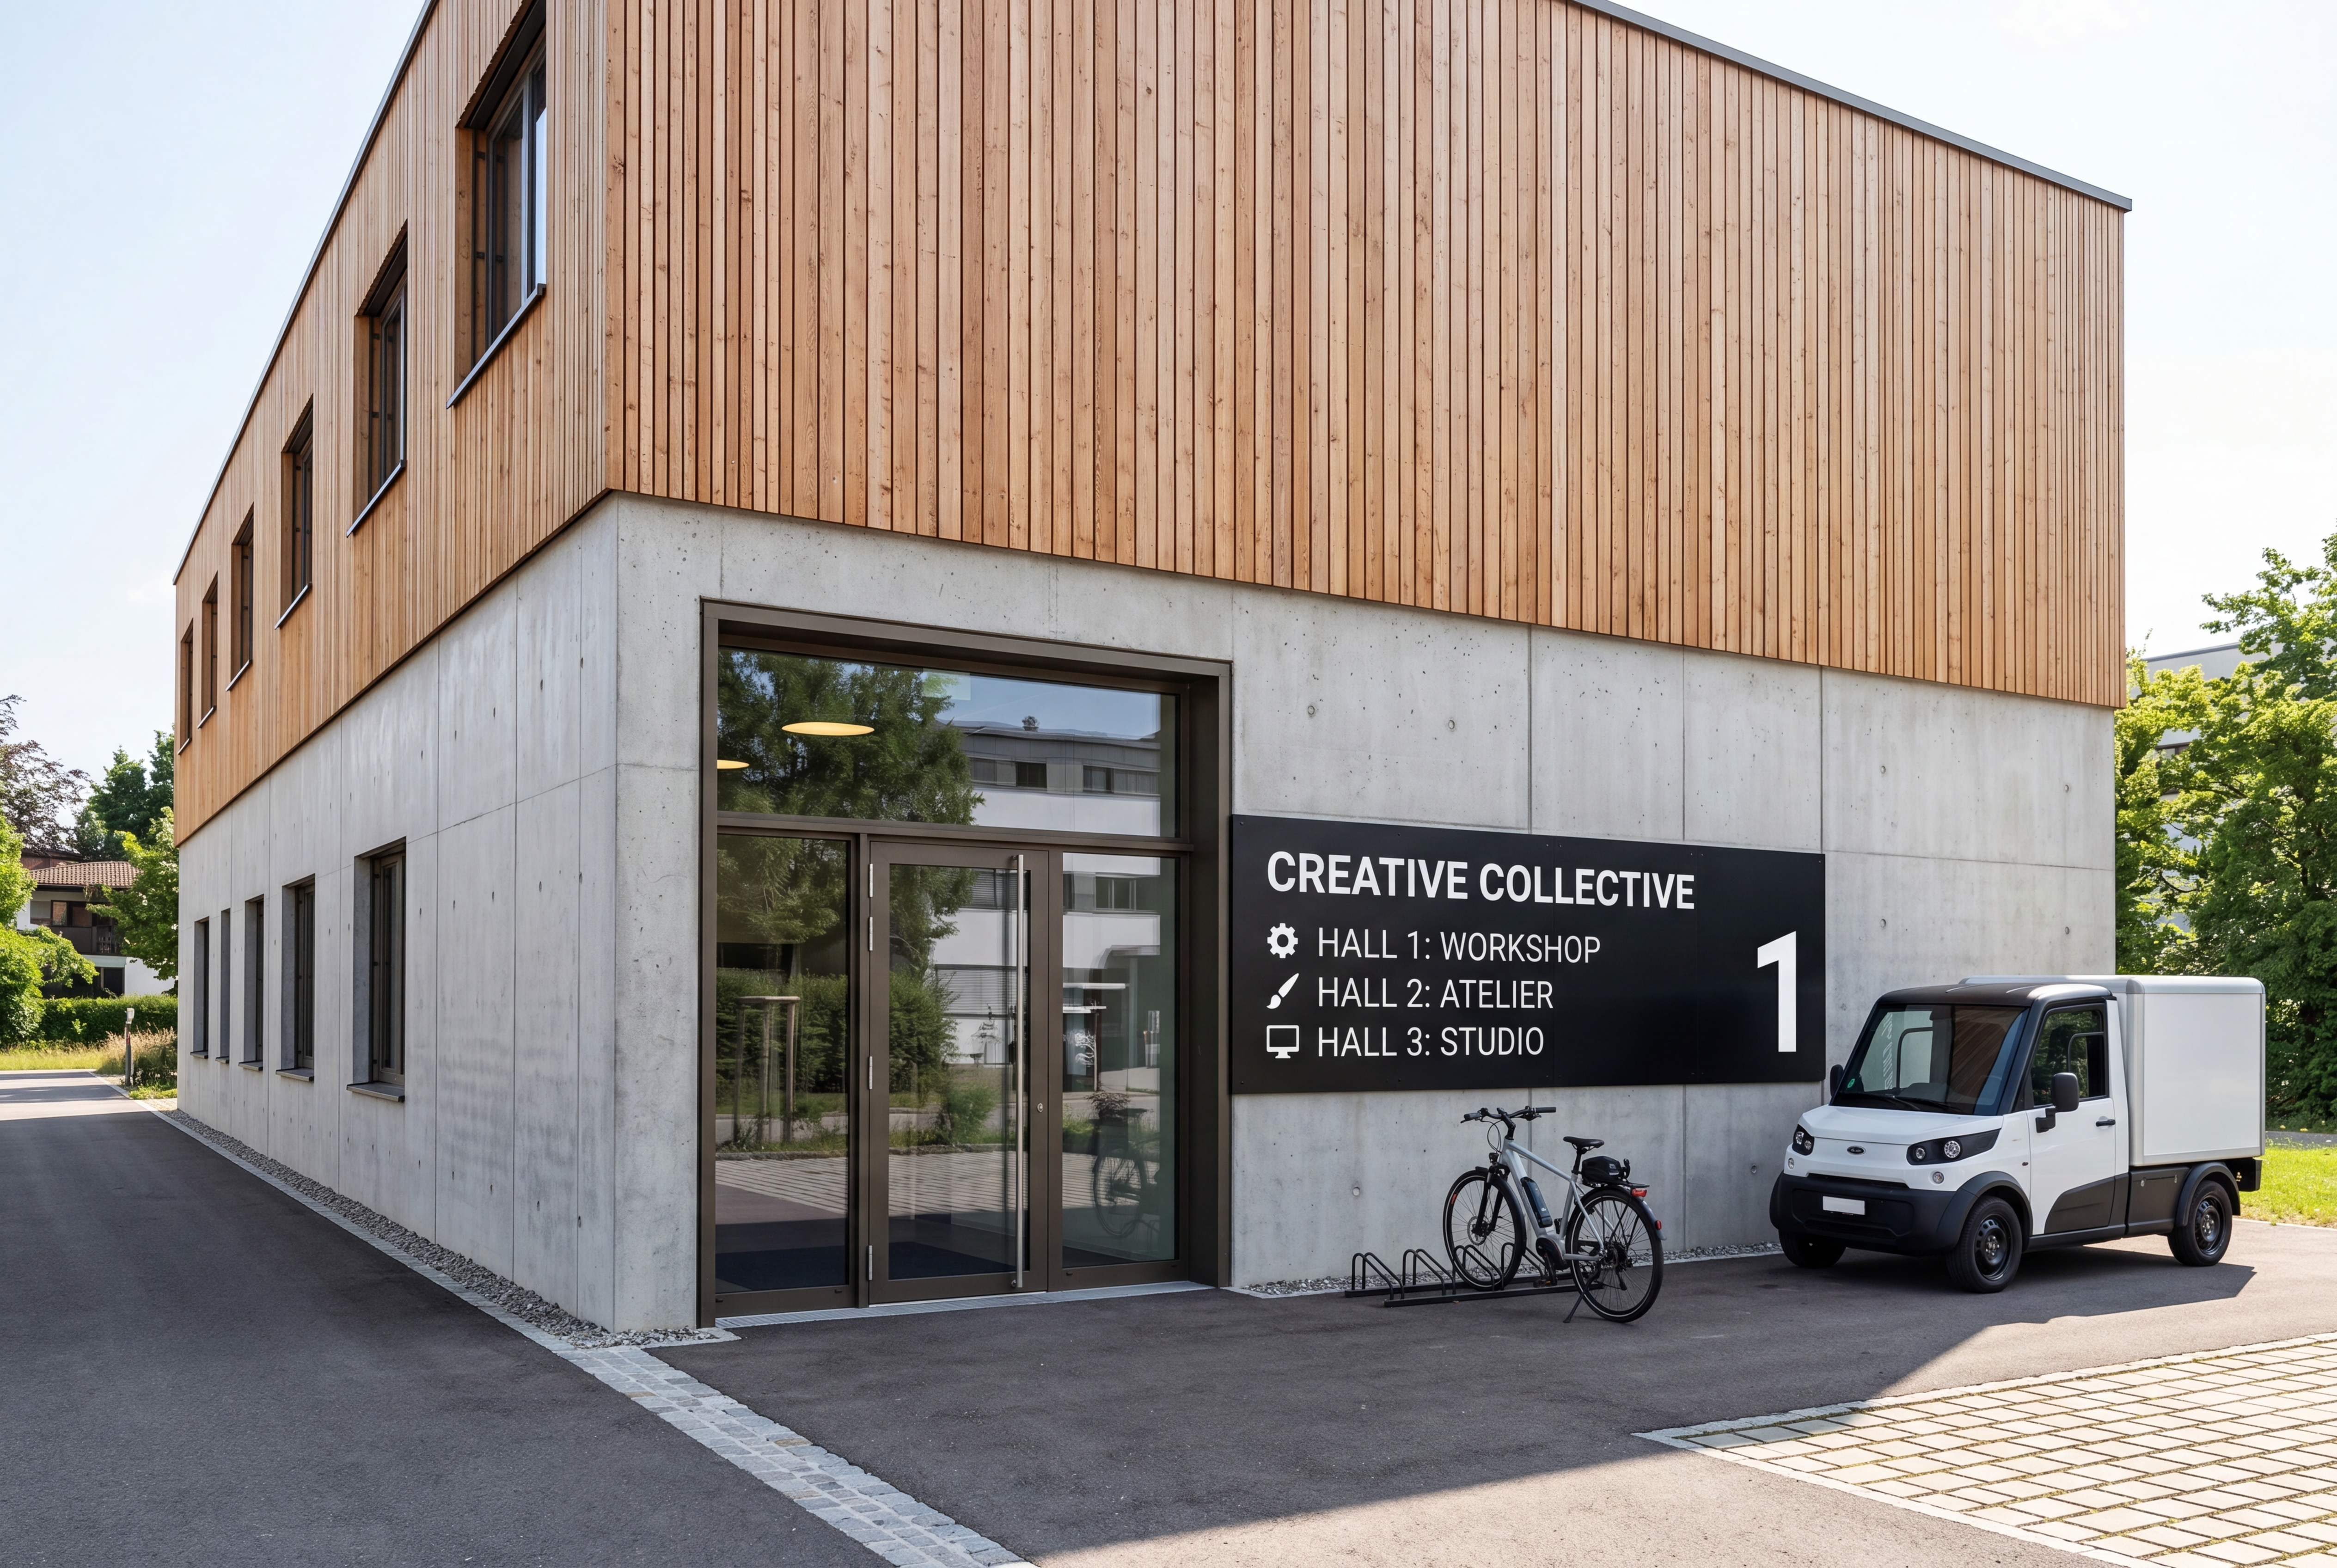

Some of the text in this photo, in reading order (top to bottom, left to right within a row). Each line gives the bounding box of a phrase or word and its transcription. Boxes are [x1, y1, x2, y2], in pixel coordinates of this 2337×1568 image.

[1267, 851, 1695, 909] CREATIVE COLLECTIVE
[1319, 927, 1600, 963] HALL 1: WORKSHOP
[1319, 977, 1554, 1009] HALL 2: ATELIER
[1757, 931, 1797, 1052] 1
[1318, 1027, 1544, 1057] HALL 3: STUDIO
